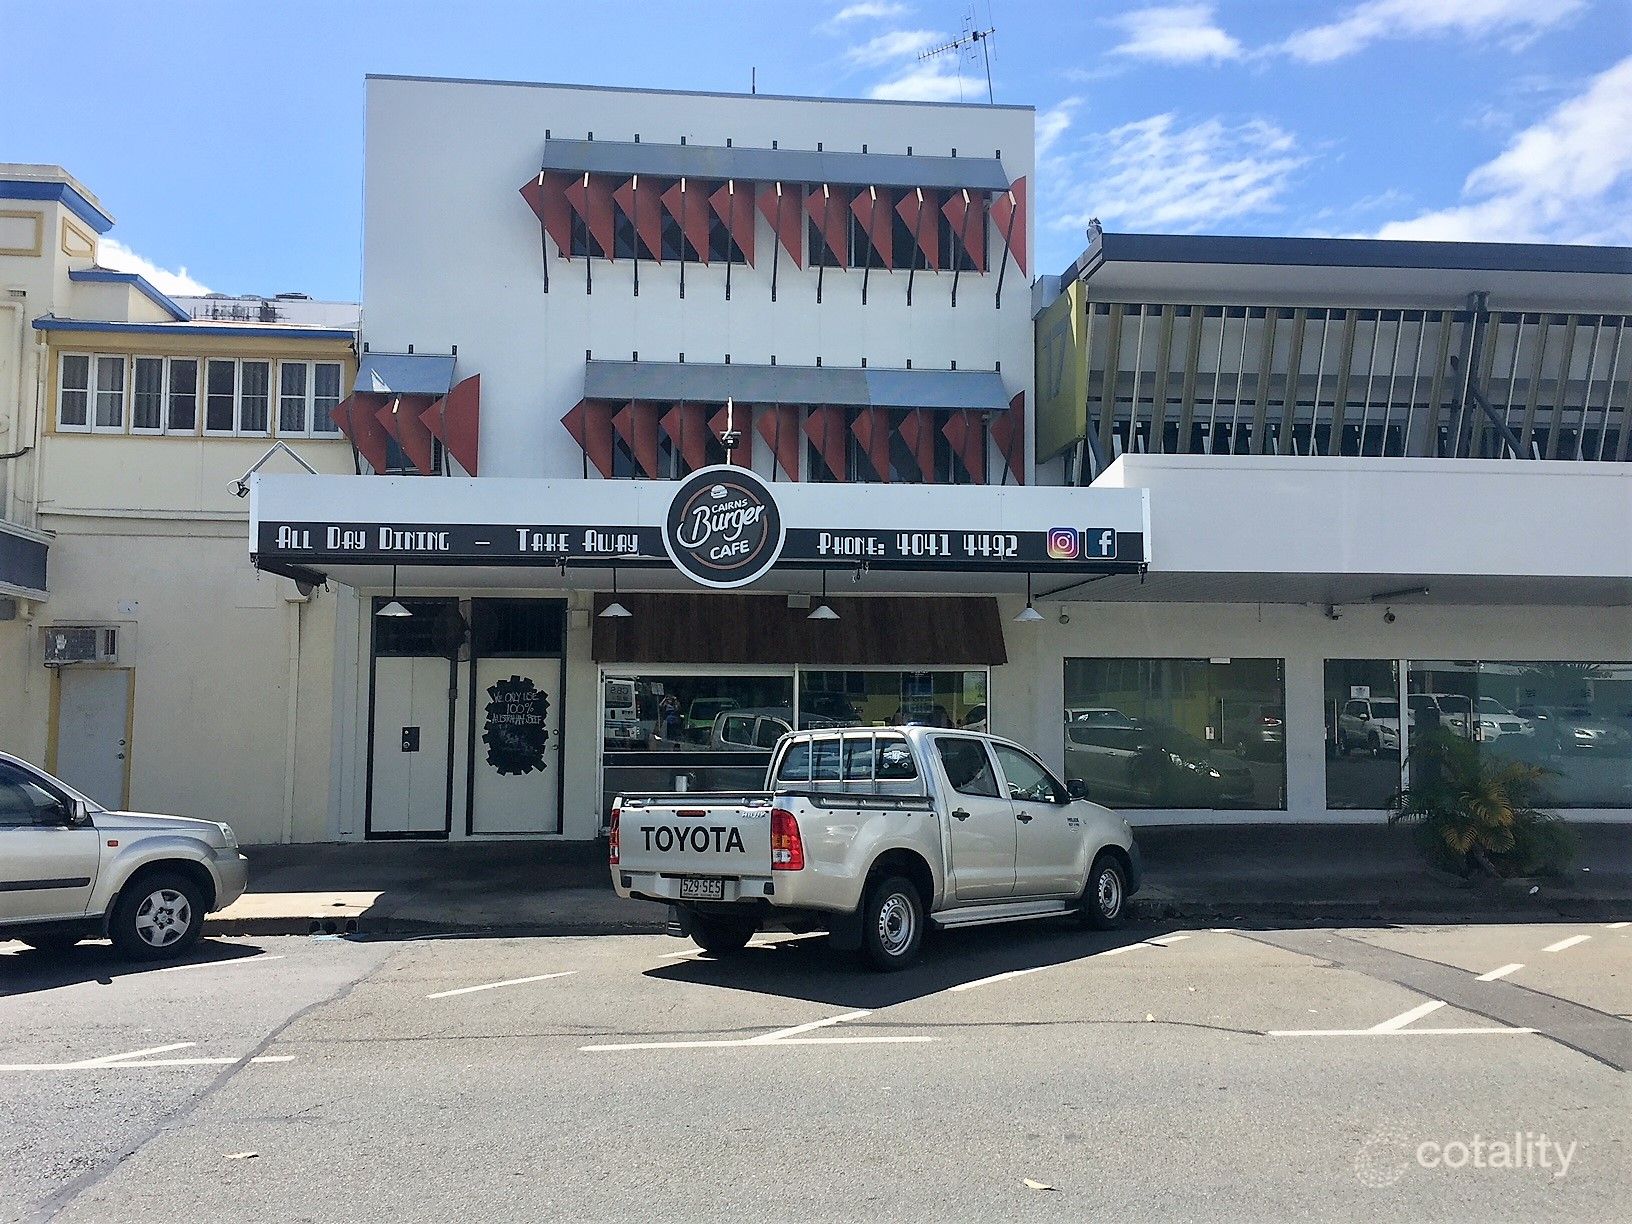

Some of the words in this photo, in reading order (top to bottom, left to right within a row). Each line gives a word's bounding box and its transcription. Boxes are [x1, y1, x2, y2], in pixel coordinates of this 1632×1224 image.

[711, 498, 748, 513] CAIRNS
[676, 505, 765, 548] Burger
[710, 540, 750, 560] CAFE
[896, 533, 951, 556] 4041
[963, 534, 1018, 557] 4492
[506, 702, 535, 714] 100%
[640, 826, 746, 853] TOYOTA
